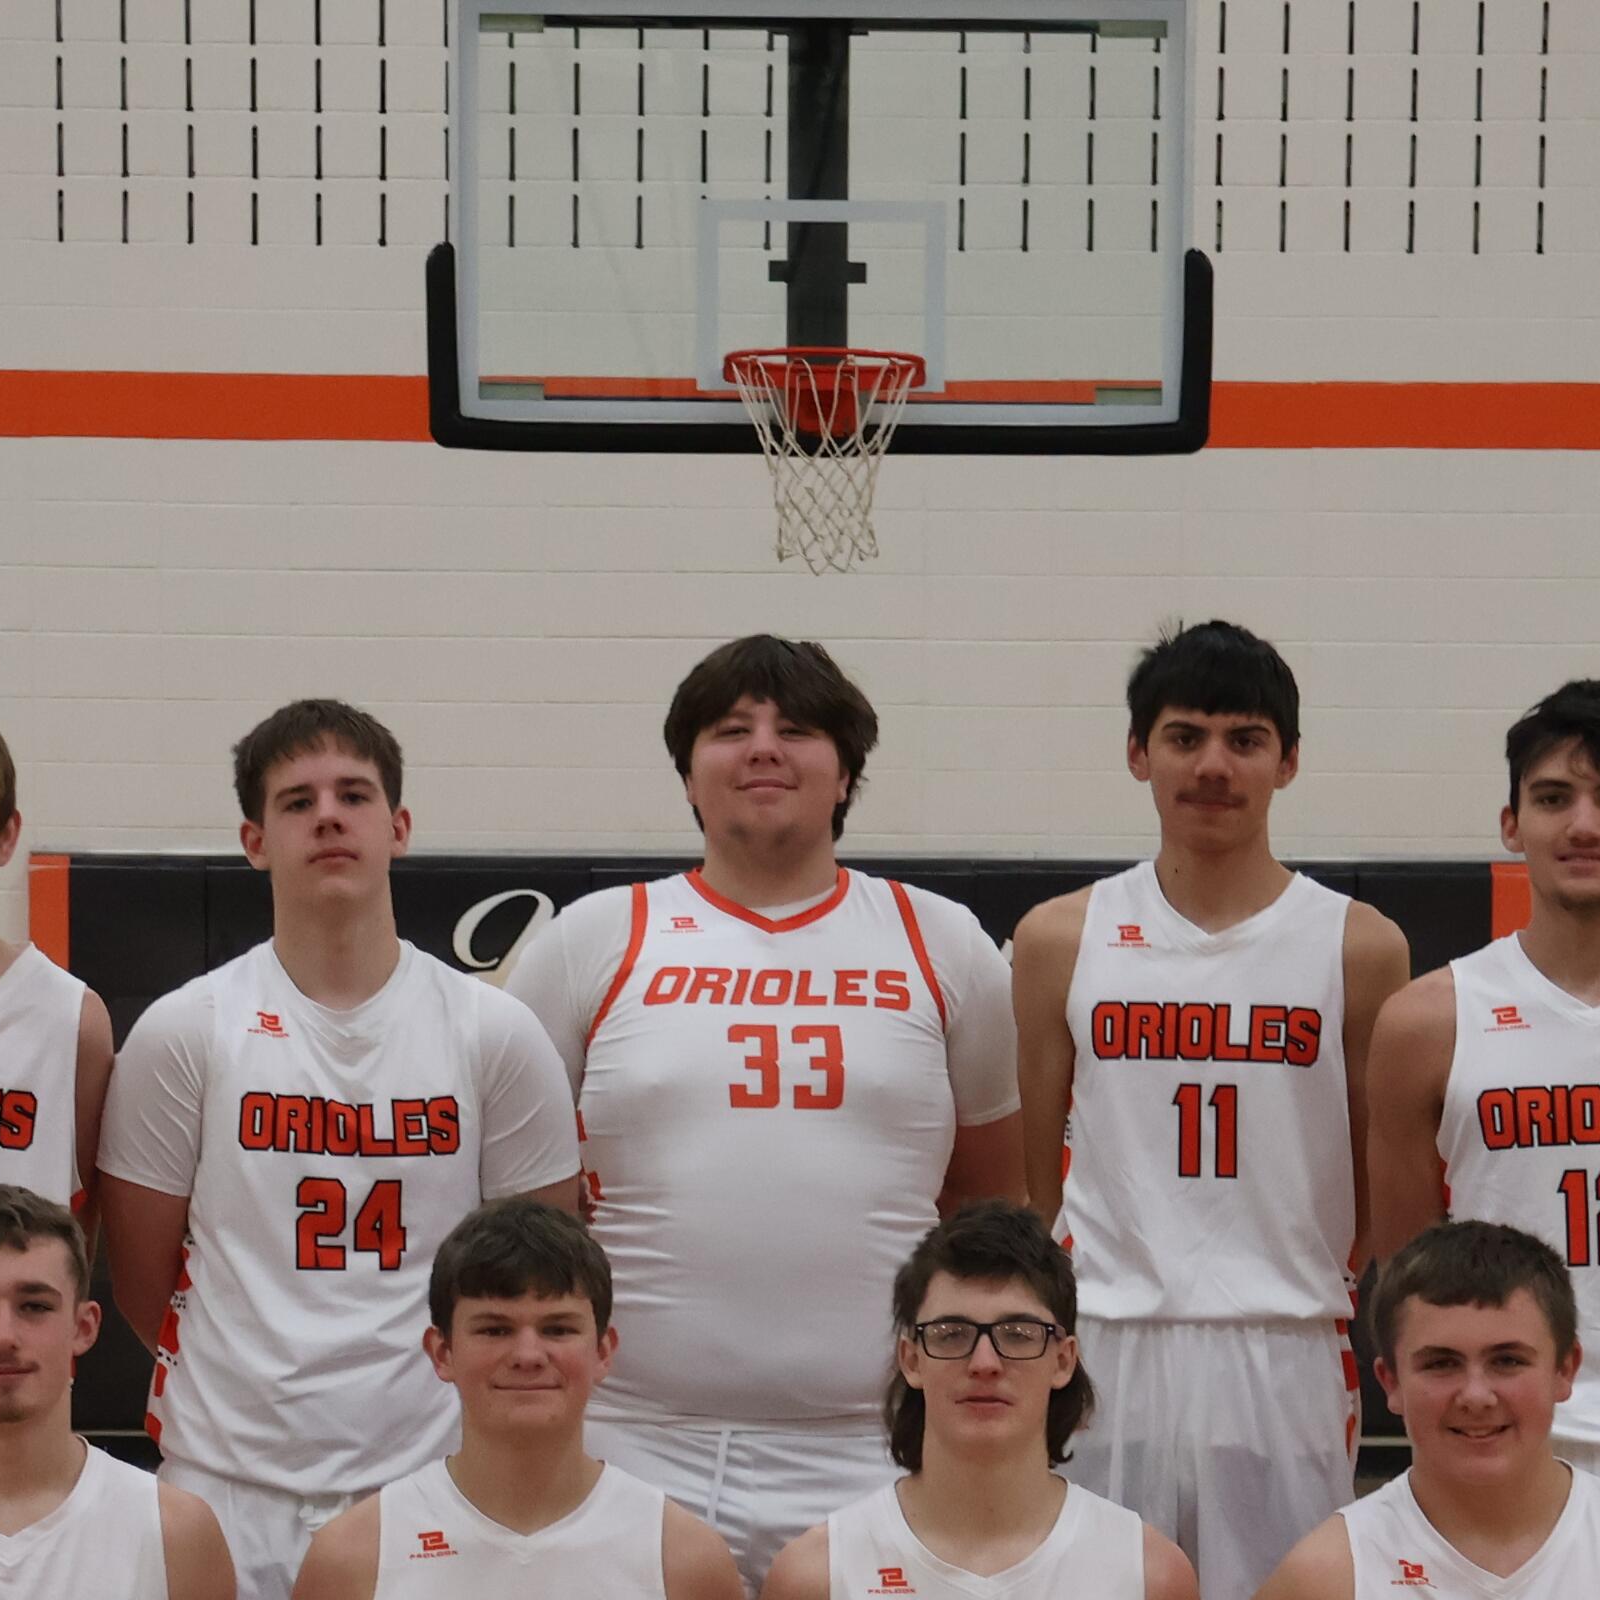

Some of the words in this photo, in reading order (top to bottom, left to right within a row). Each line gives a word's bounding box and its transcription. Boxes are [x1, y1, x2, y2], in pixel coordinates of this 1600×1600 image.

[643, 966, 911, 1012] ORIOLES
[728, 1024, 845, 1110] 33
[1092, 1001, 1321, 1067] ORIOLES
[239, 1091, 461, 1156] ORIOLES
[1172, 1084, 1238, 1179] 11
[295, 1176, 406, 1271] 24
